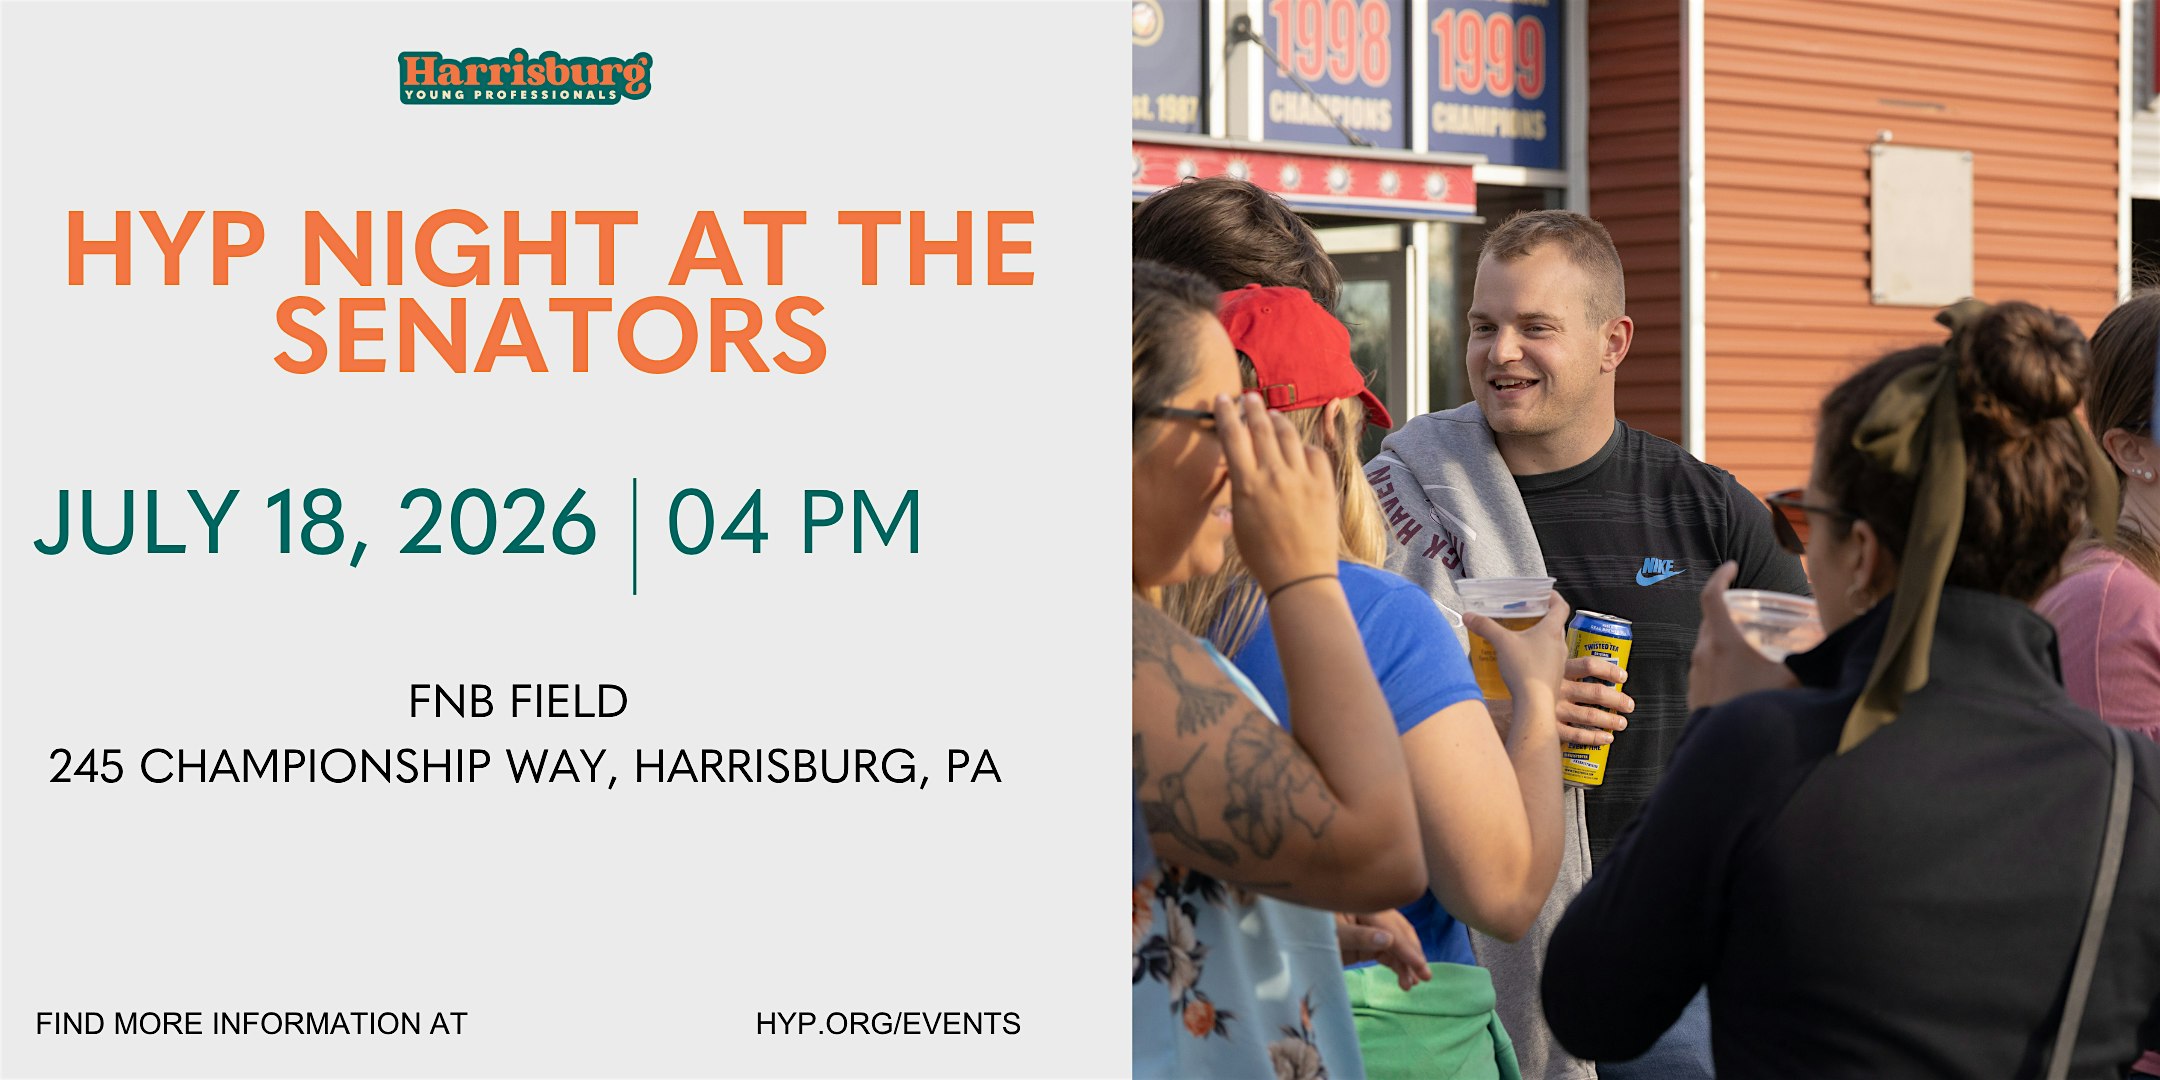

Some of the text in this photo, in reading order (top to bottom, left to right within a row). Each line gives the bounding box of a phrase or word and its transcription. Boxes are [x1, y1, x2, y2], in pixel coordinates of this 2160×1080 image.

[1269, 0, 1391, 87] 1998
[1432, 8, 1546, 99] 1999
[1269, 88, 1393, 133] CHAMPIONS
[1432, 101, 1547, 141] CHAMPIONS
[1366, 465, 1424, 546] HAVEN
[1422, 533, 1464, 574] CK
[1642, 557, 1675, 575] NIKE
[1584, 643, 1609, 651] TWISTED
